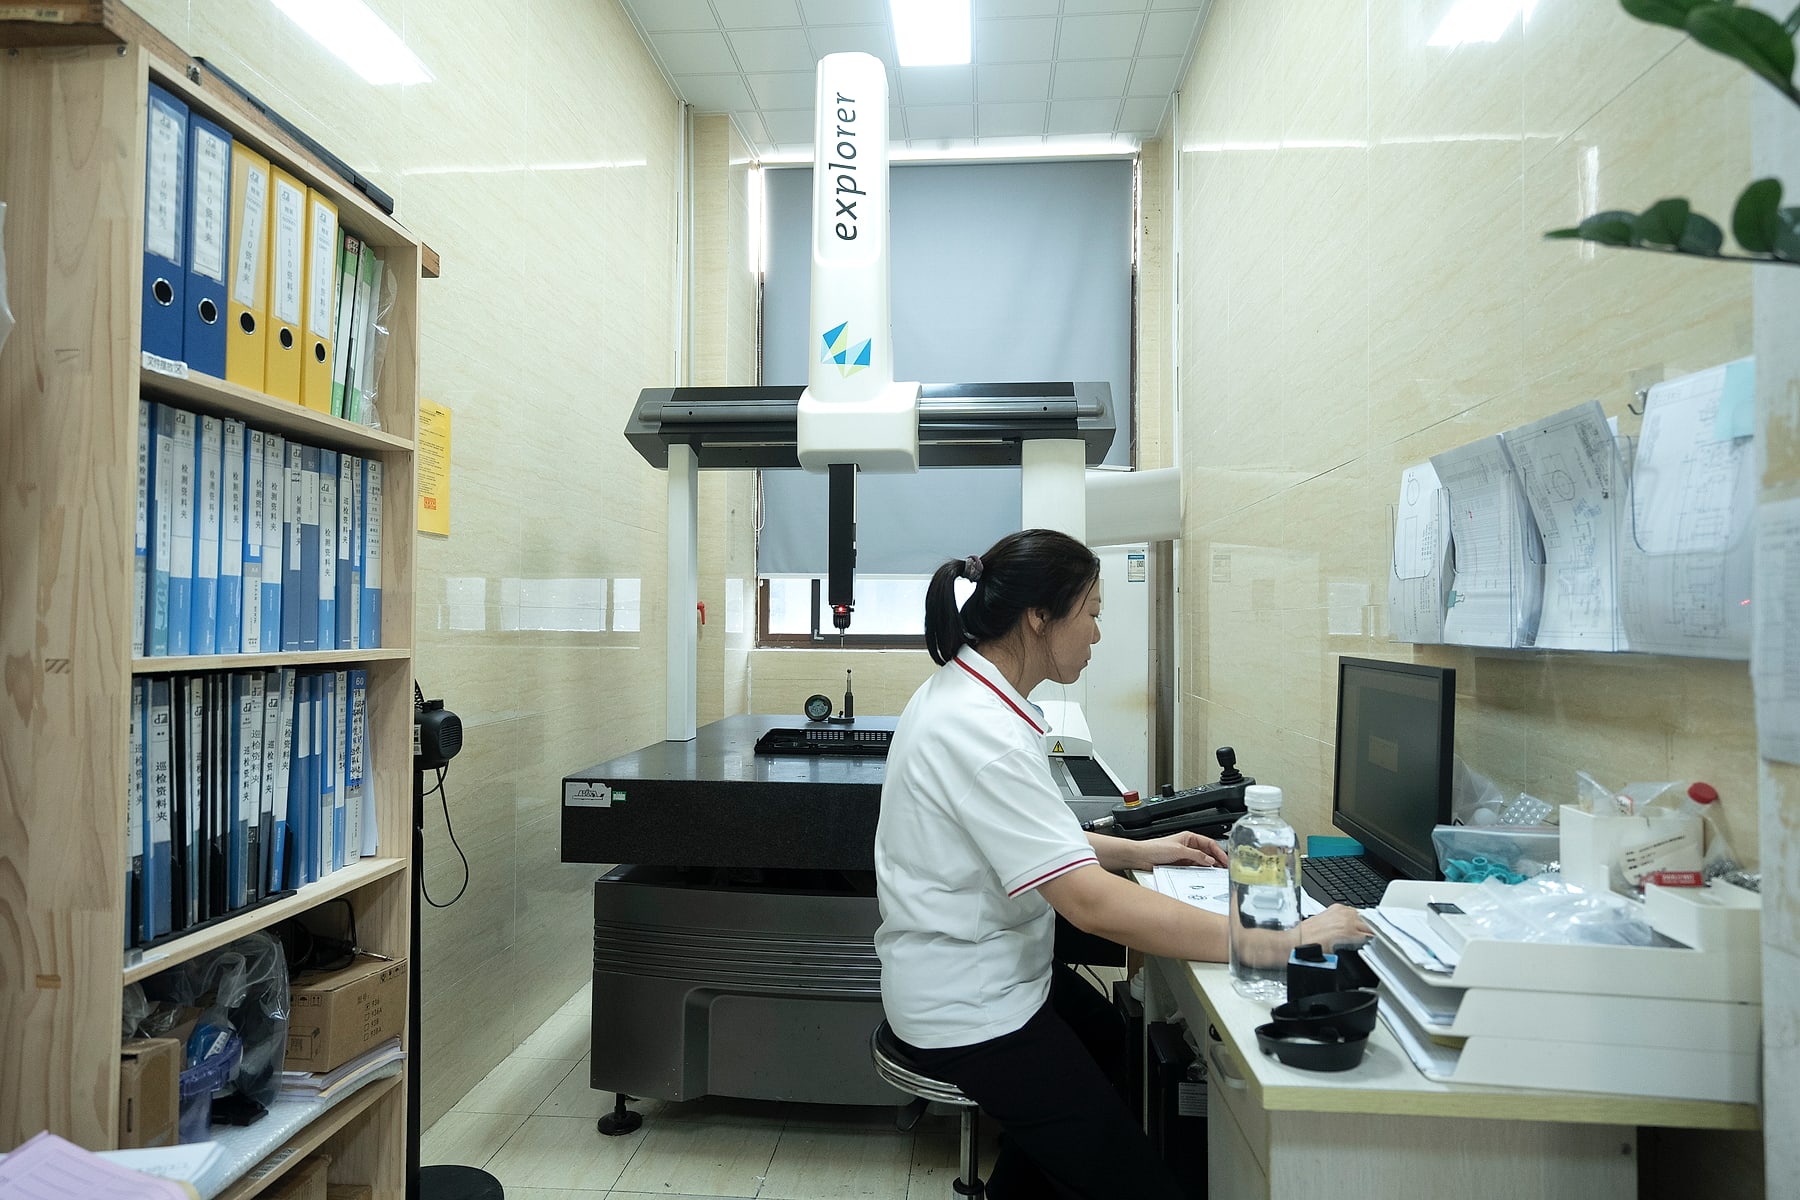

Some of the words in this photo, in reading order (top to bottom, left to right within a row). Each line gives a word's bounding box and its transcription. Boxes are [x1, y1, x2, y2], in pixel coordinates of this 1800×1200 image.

[828, 91, 866, 242] explorer
[180, 464, 189, 520] 检测资料夹
[270, 482, 278, 532] 检测资料夹
[355, 677, 365, 686] 60
[155, 760, 168, 823] 巡检资料夹
